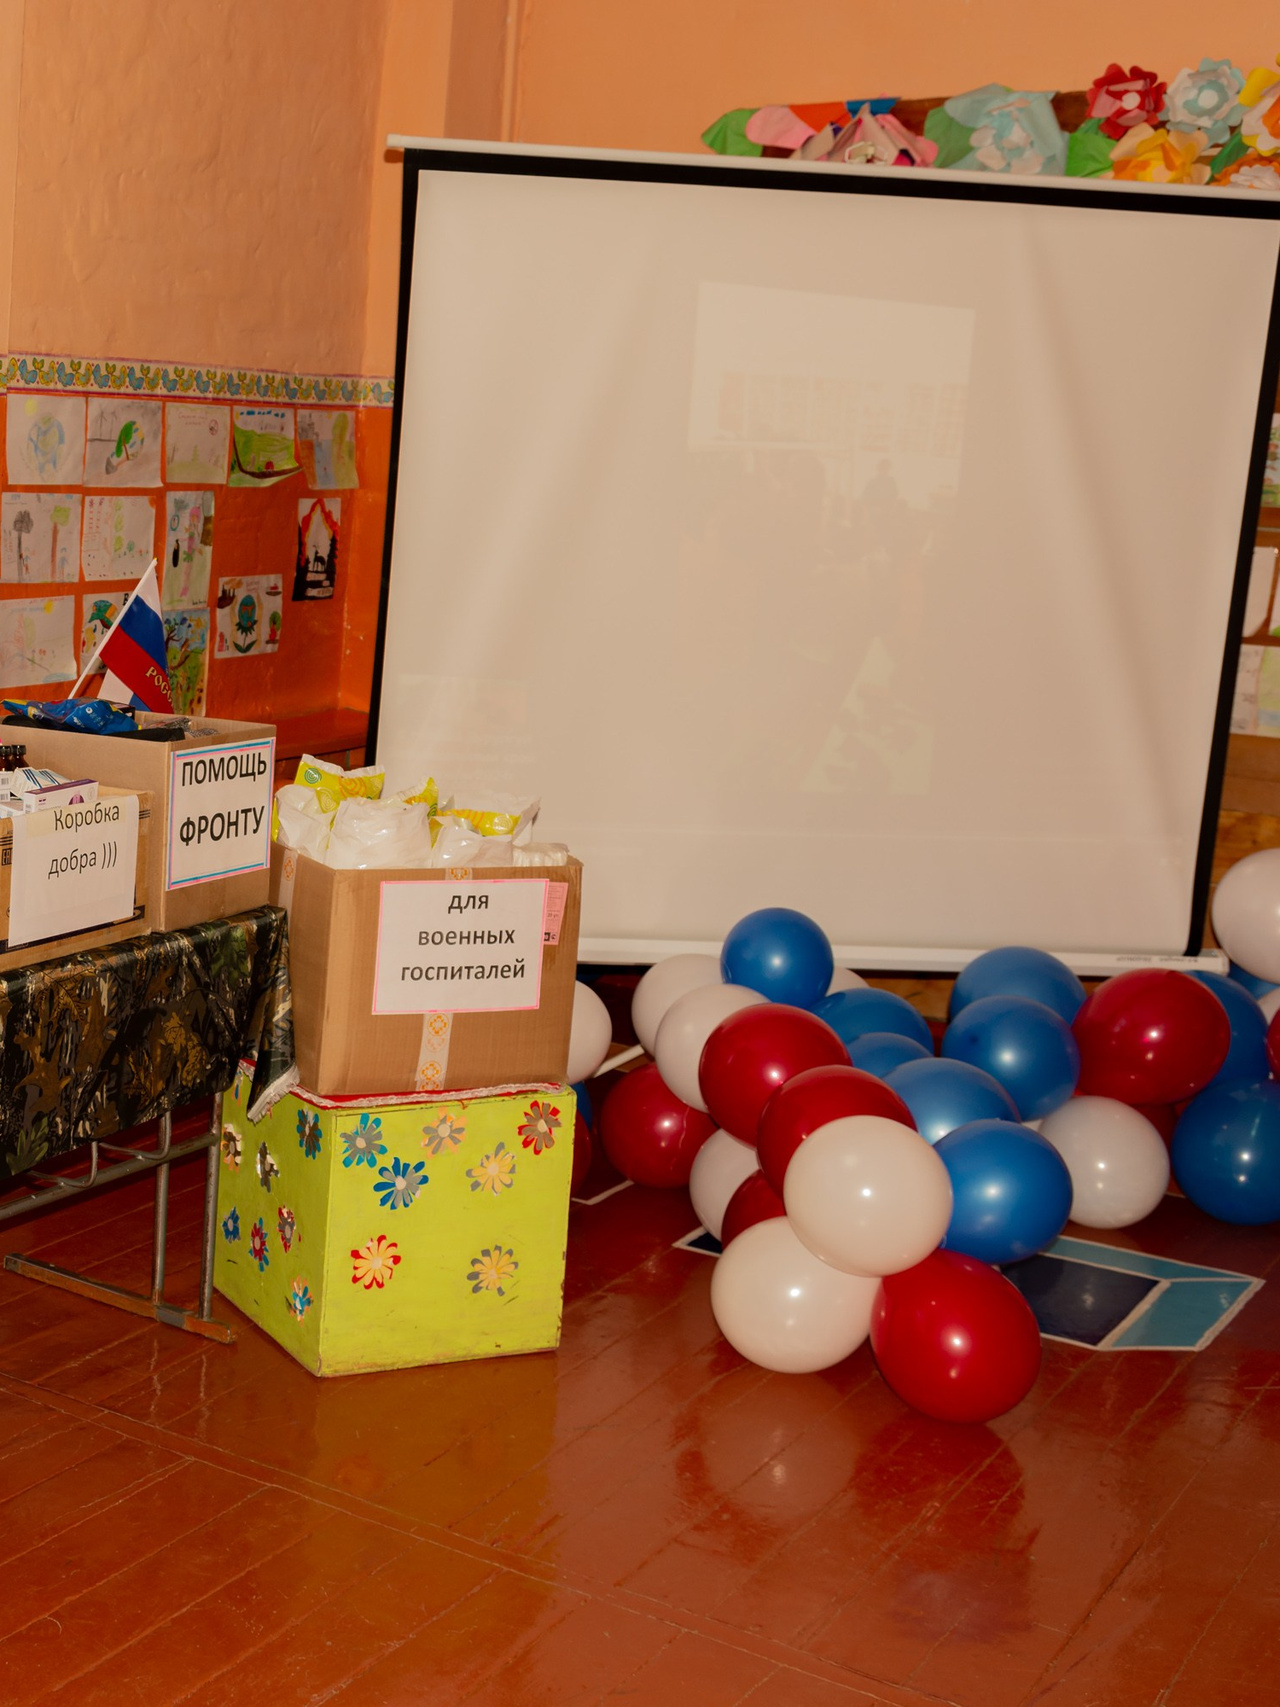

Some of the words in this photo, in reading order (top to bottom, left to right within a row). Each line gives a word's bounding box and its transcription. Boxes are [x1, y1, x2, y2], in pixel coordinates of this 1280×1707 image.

[182, 752, 267, 787] ПОМОЩЬ
[54, 802, 120, 832] Коробка
[179, 805, 265, 846] ФРОНТУ
[48, 848, 97, 879] добра
[101, 841, 118, 869] )))
[448, 894, 489, 914] для
[418, 929, 516, 946] военных
[401, 958, 525, 981] госпиталей
